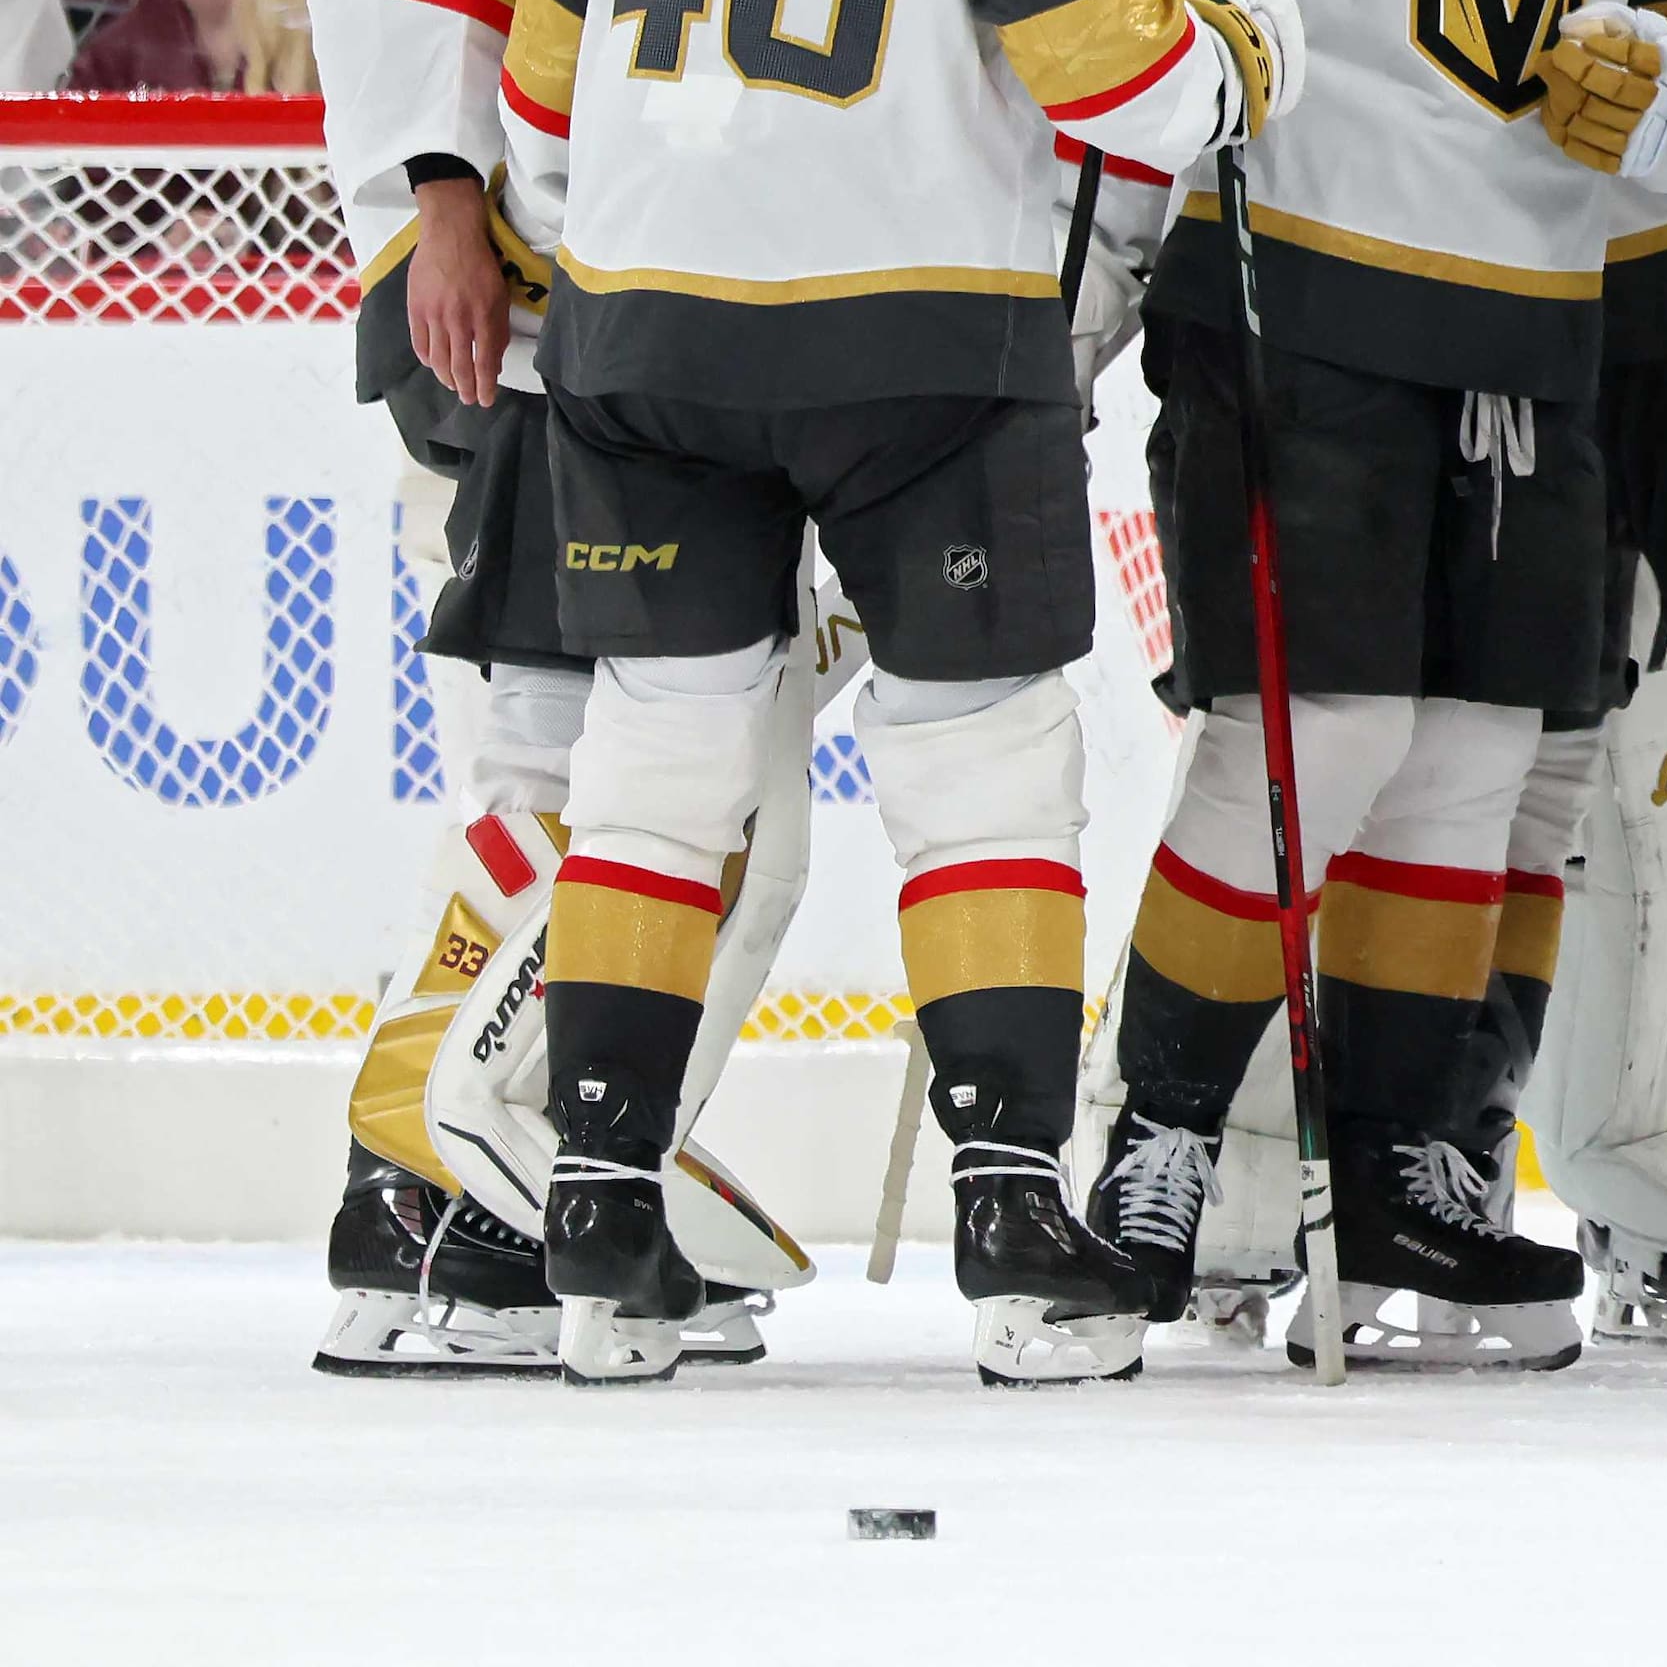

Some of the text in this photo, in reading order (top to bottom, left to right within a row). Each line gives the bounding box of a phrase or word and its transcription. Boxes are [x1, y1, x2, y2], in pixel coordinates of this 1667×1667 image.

[565, 542, 679, 573] CCM
[953, 555, 979, 580] NHL
[438, 933, 488, 978] 33
[473, 926, 548, 1063] rian's
[1392, 1233, 1459, 1269] BAUER
